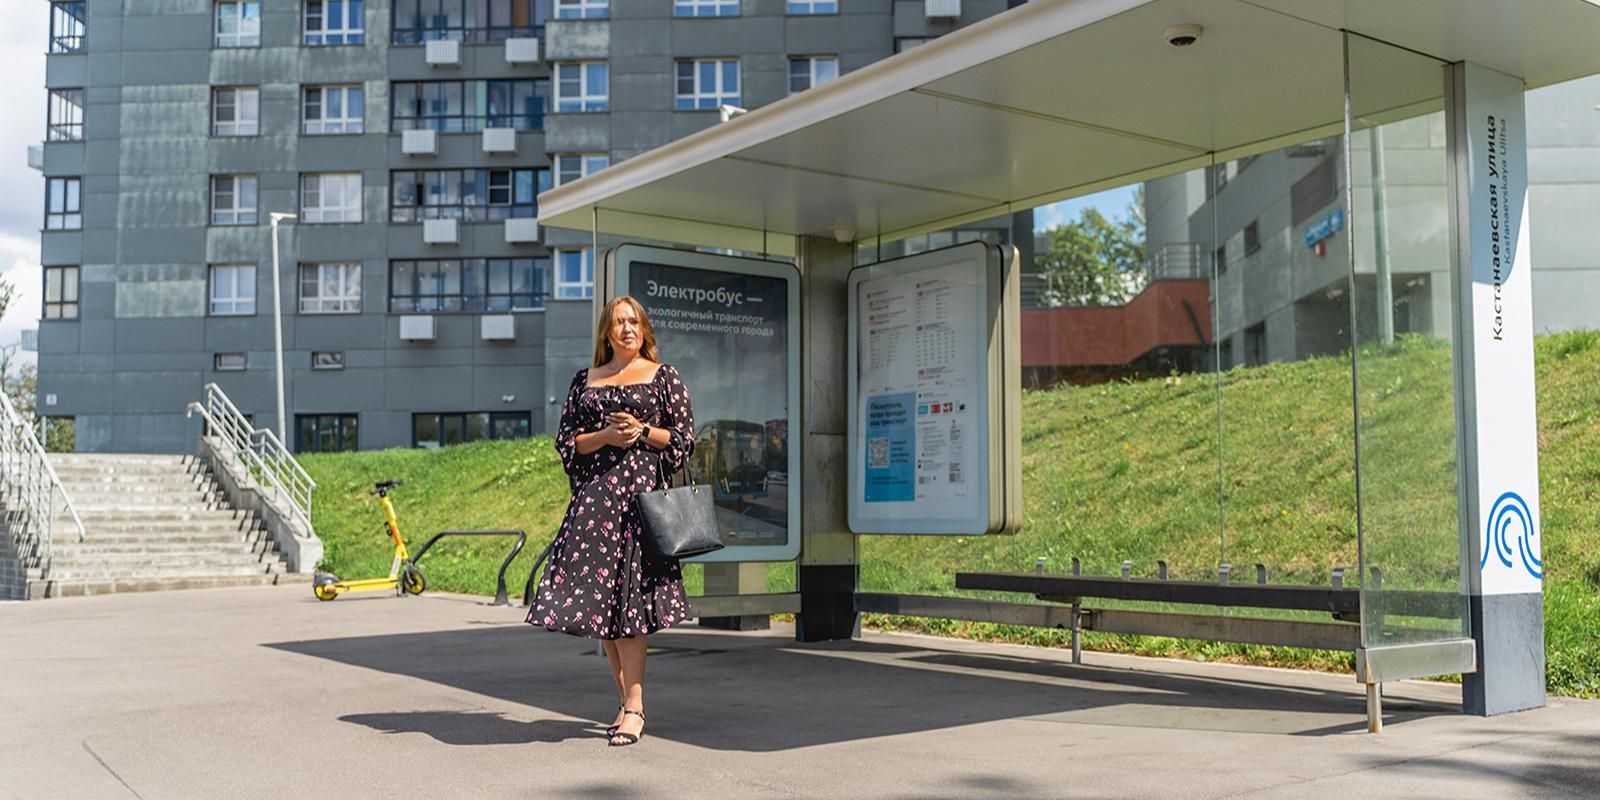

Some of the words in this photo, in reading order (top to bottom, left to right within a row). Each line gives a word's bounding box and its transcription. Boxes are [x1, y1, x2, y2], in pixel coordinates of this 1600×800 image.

[1487, 115, 1499, 179] улица
[1489, 184, 1503, 341] Кастанаевская
[647, 280, 743, 307] Электробус
[647, 306, 713, 320] экологичный
[715, 312, 764, 325] транспорт
[668, 320, 739, 333] современного
[741, 325, 774, 337] города
